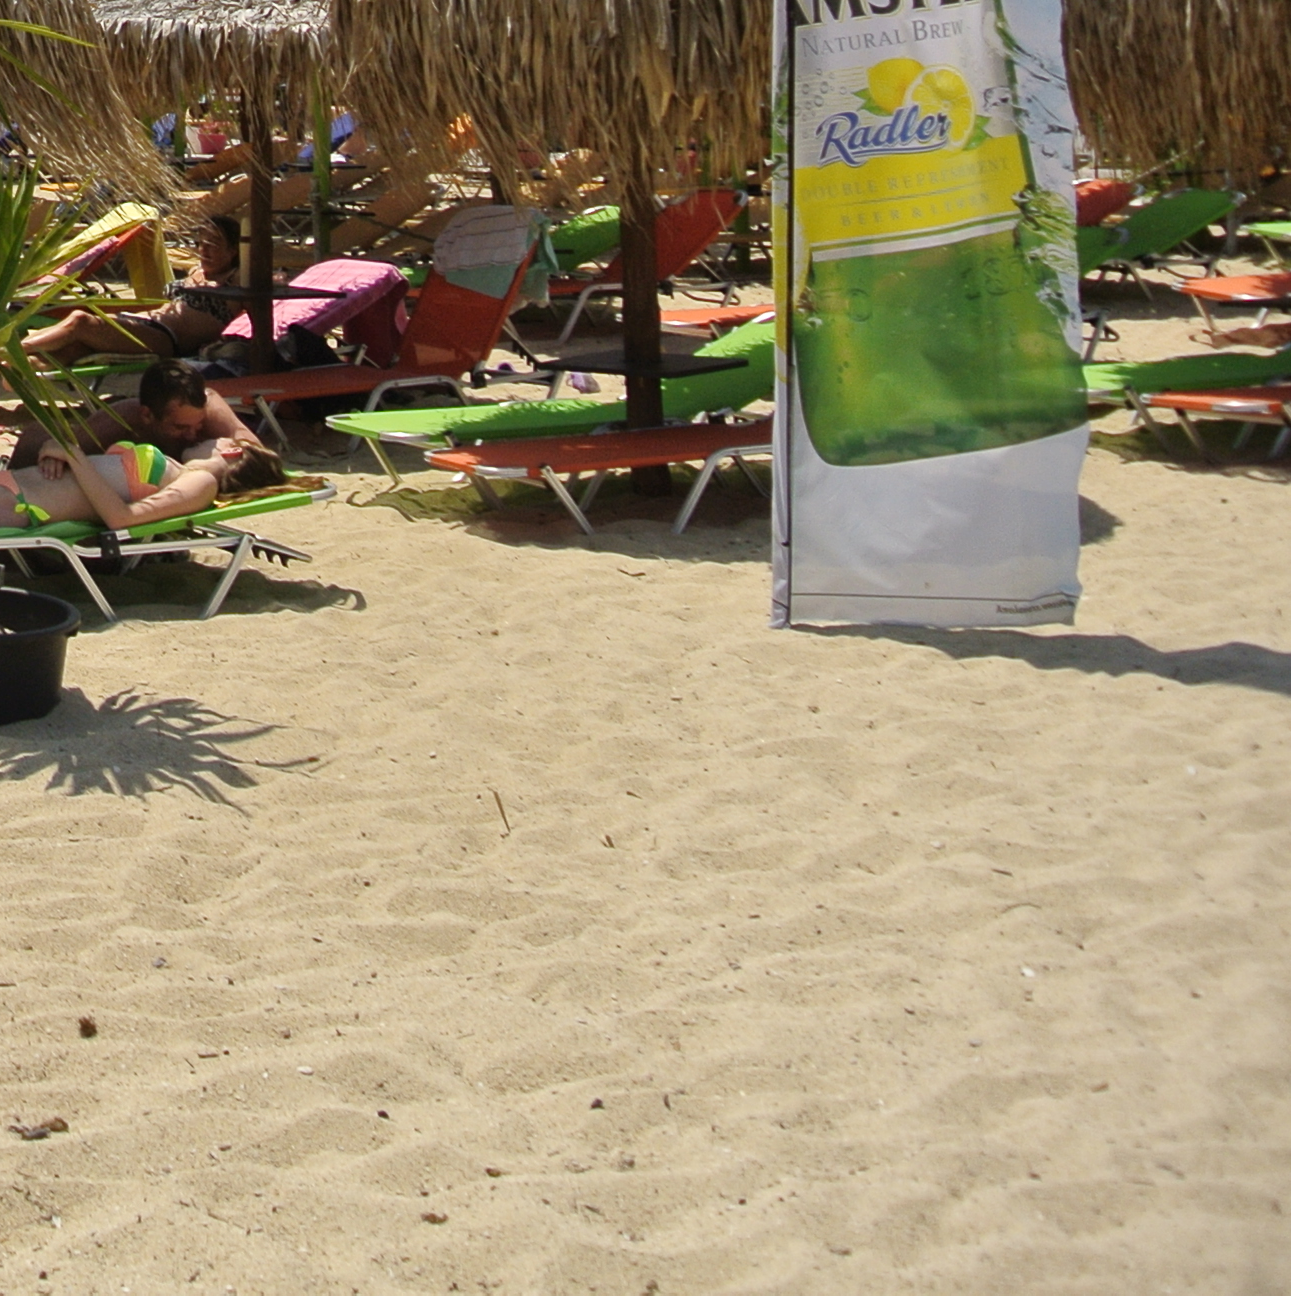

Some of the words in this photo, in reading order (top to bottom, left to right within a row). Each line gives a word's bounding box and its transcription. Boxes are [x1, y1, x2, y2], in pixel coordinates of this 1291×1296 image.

[802, 28, 906, 57] NATURAL
[912, 19, 965, 42] BREW
[816, 104, 952, 167] Radler
